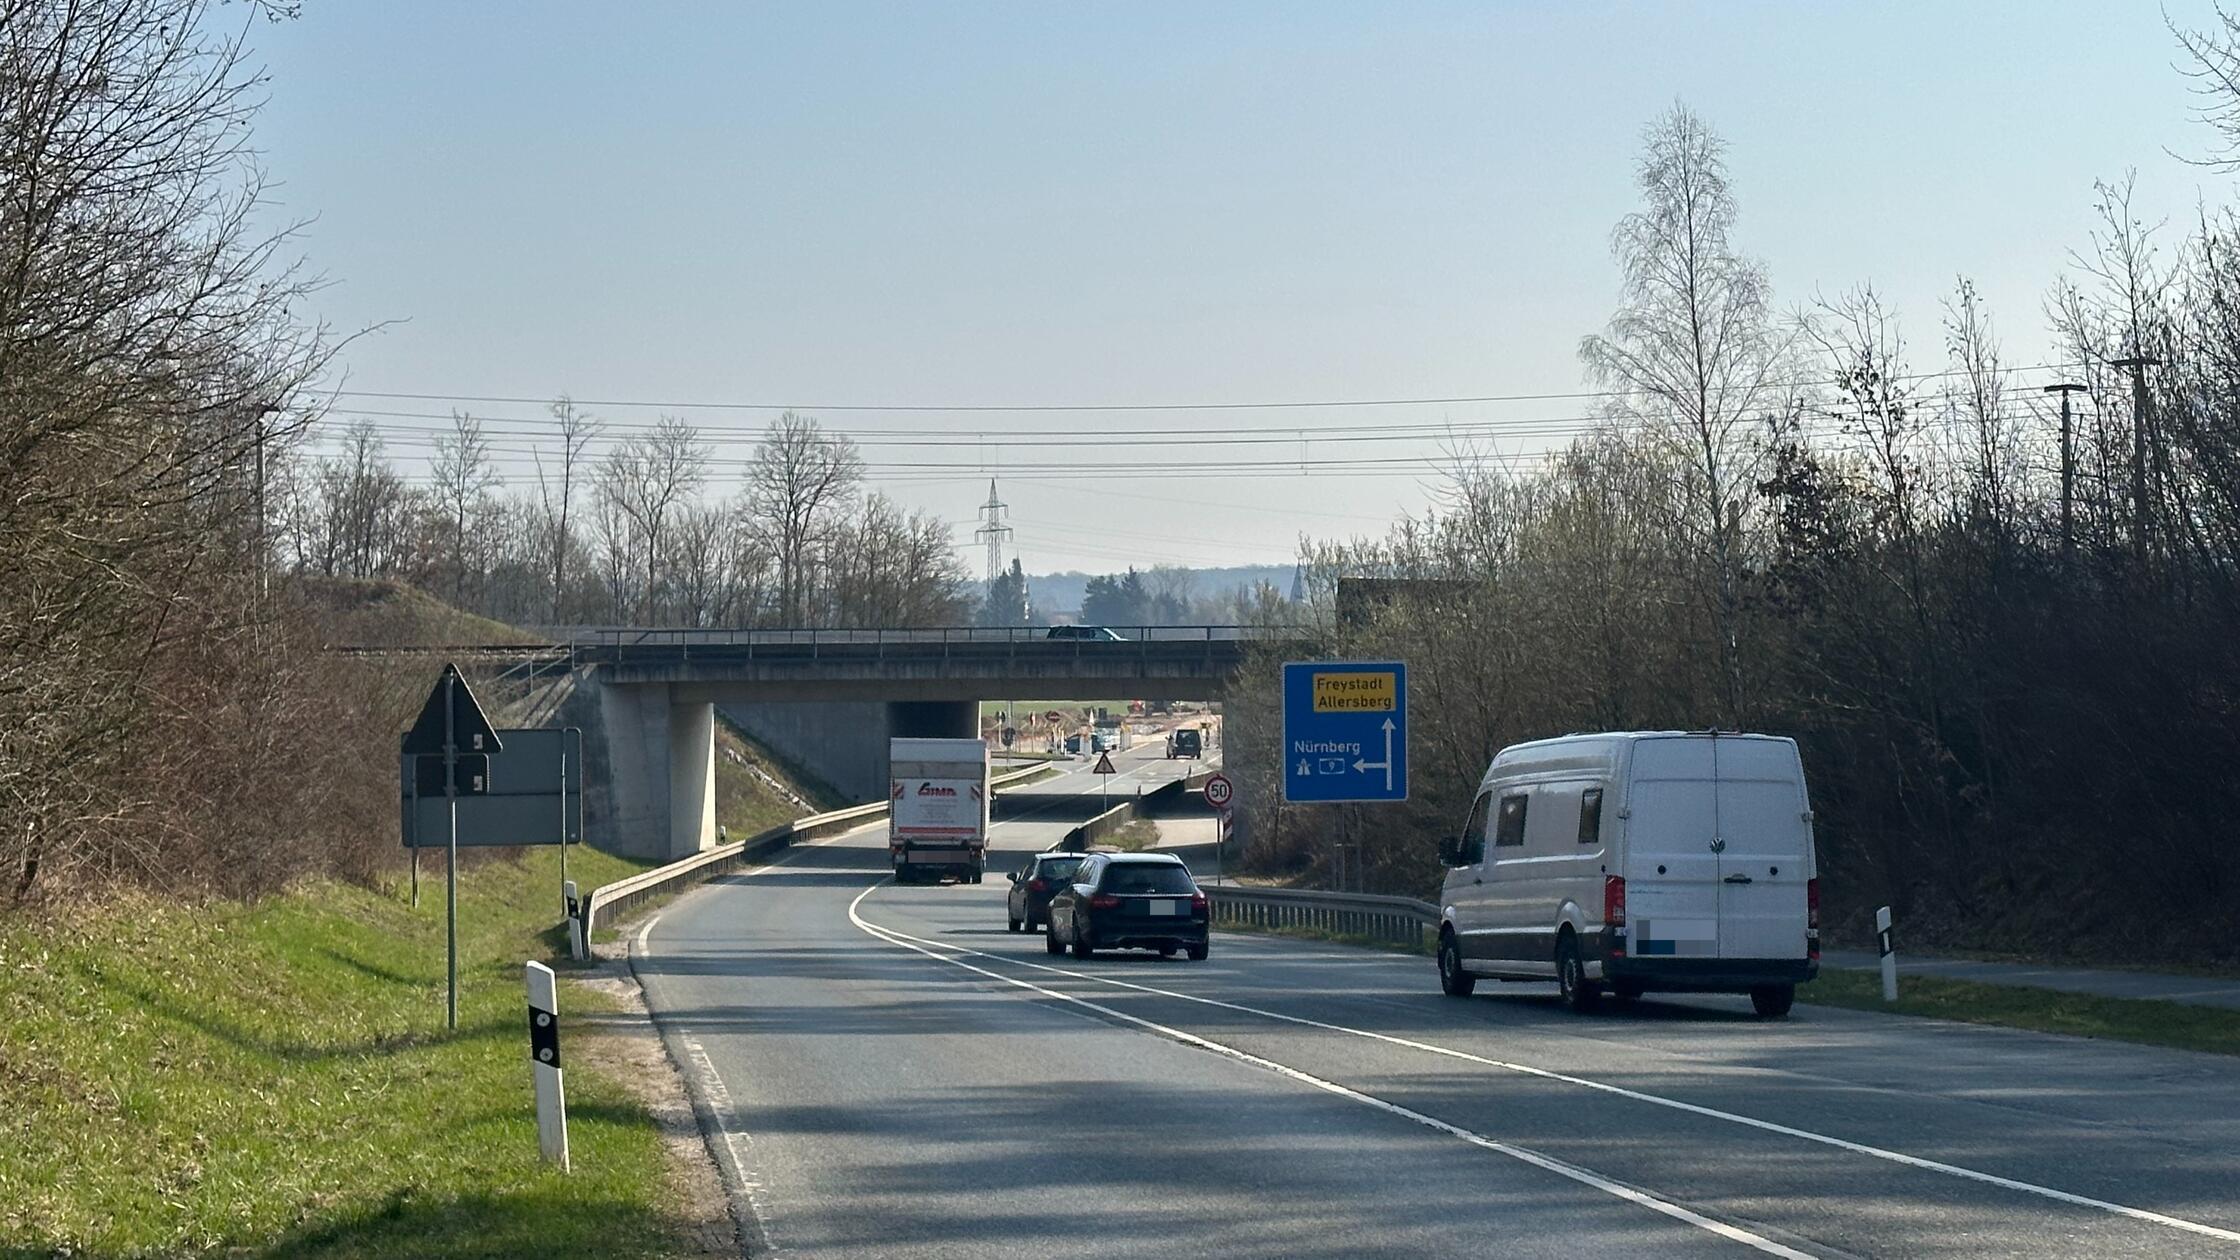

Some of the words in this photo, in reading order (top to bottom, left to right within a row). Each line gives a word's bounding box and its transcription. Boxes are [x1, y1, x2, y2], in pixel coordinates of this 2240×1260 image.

[1317, 678, 1382, 692] Freystadt
[1318, 695, 1392, 710] Allersberg
[1294, 740, 1361, 755] Nürnberg
[1328, 761, 1336, 770] 9
[1211, 784, 1227, 798] 50
